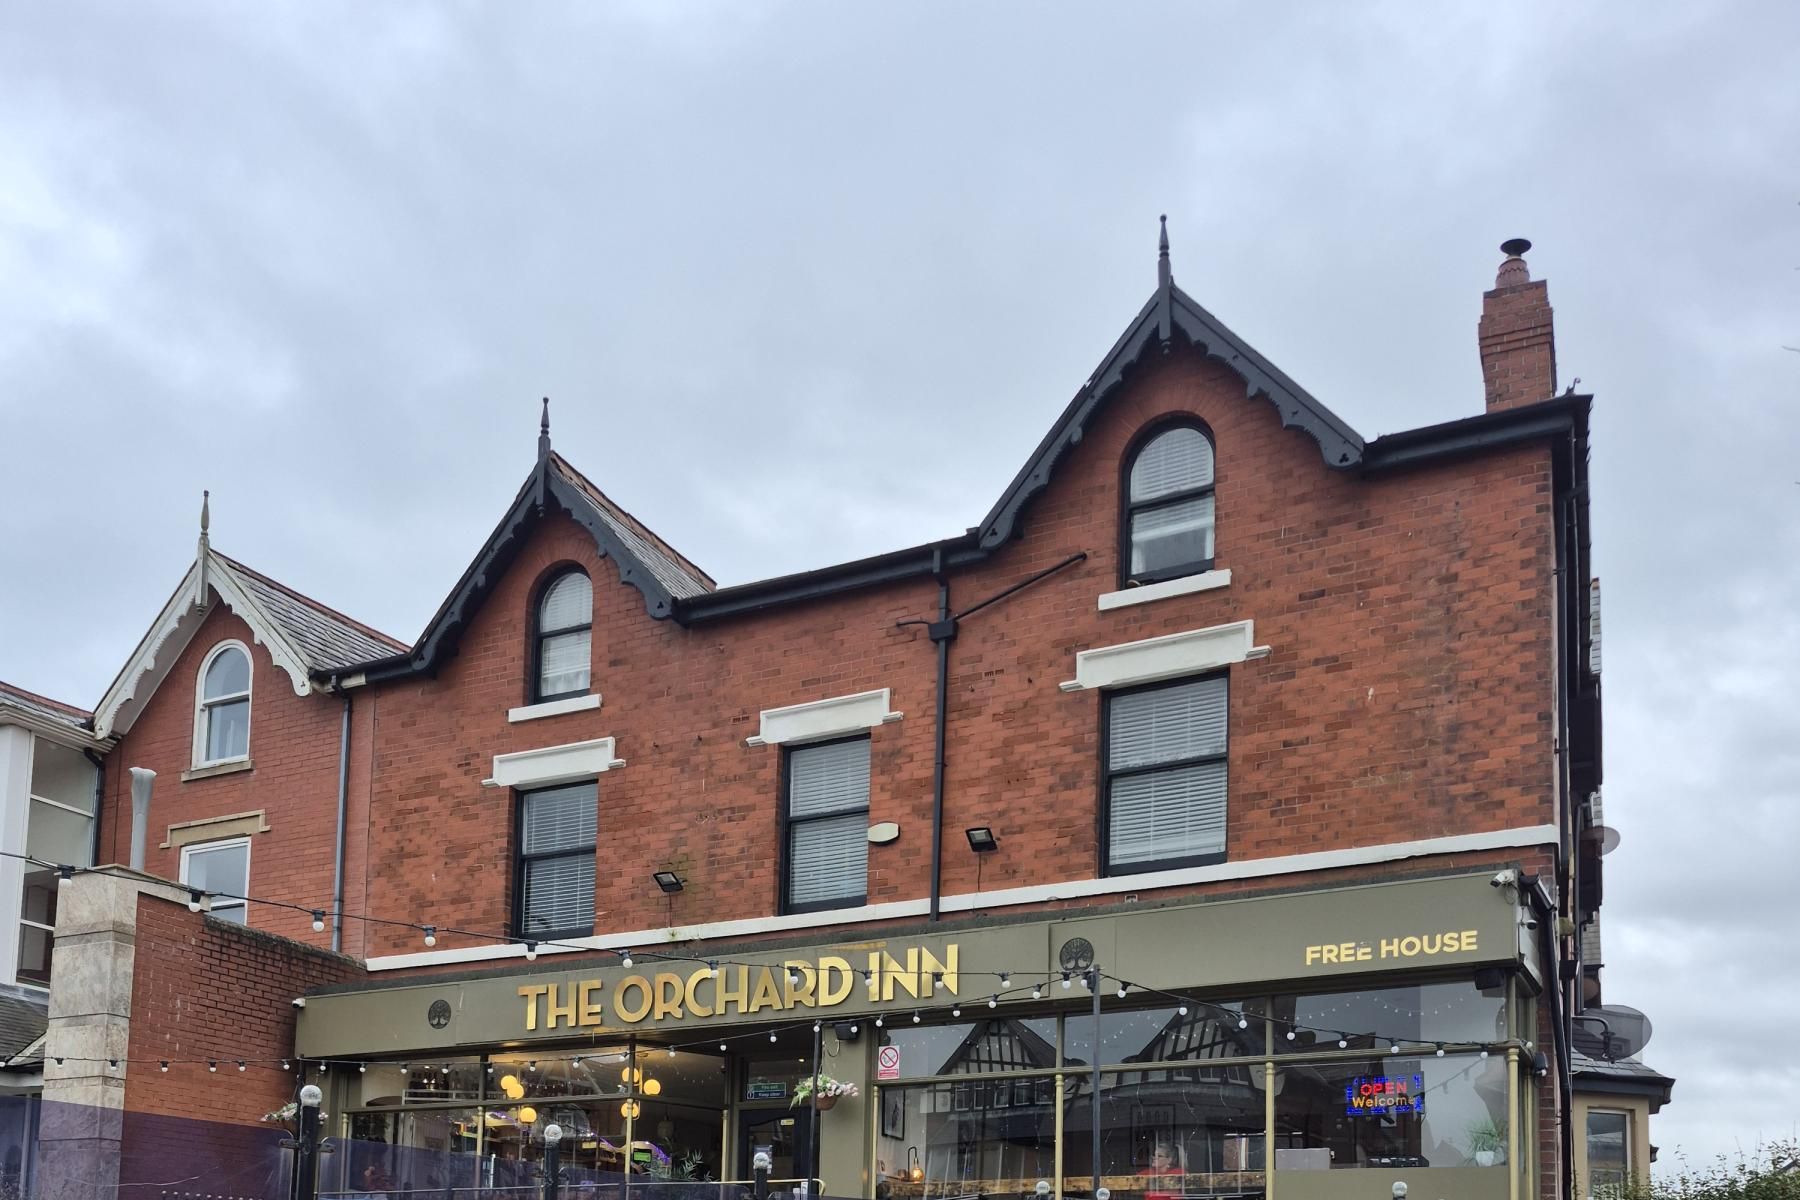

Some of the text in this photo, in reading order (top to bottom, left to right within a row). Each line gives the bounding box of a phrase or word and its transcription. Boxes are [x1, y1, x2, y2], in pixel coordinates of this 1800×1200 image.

[1306, 930, 1478, 965] FREE HOUSE
[518, 943, 958, 1030] THE ORCHARD INN
[1361, 1081, 1407, 1096] OPEN
[1352, 1096, 1415, 1108] Welcome
